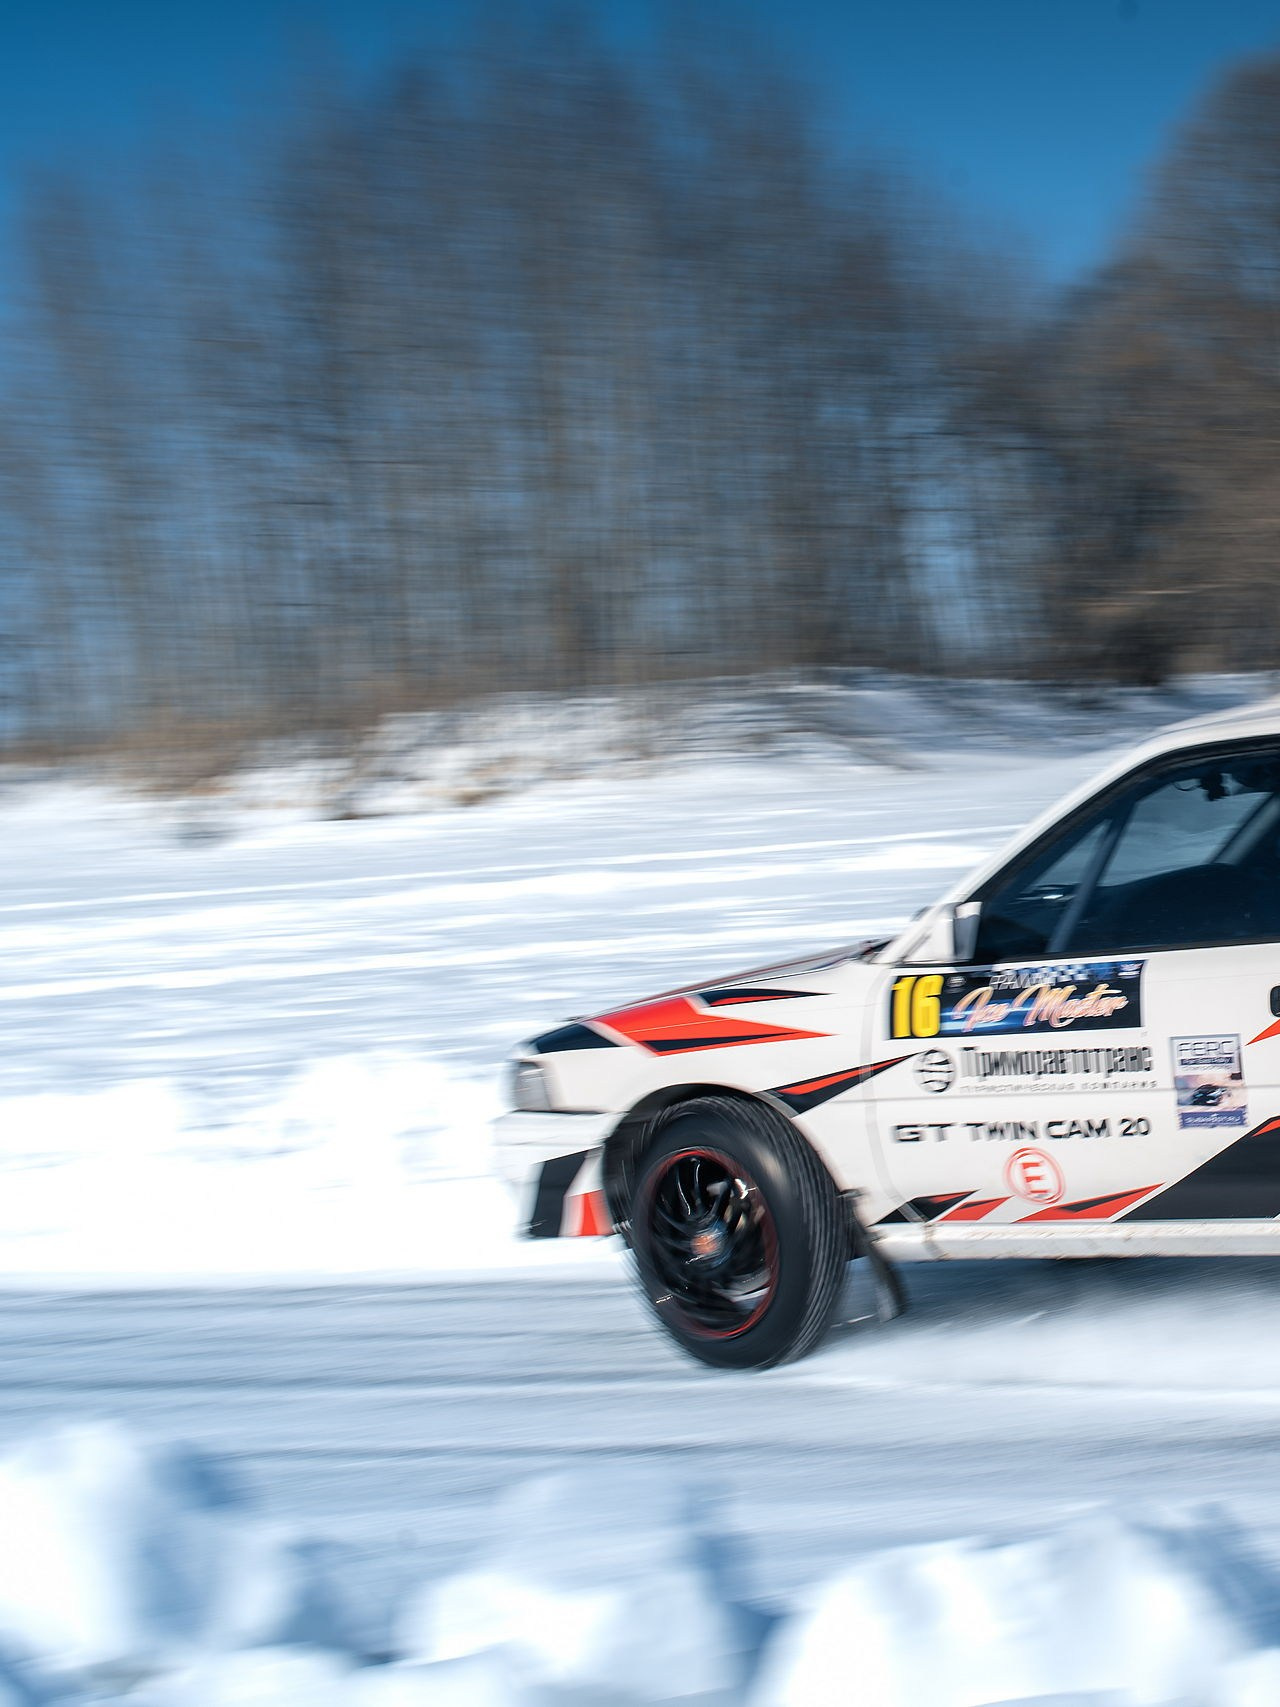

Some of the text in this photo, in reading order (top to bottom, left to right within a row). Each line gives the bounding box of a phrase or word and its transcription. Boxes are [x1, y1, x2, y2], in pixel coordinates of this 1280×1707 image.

[892, 974, 945, 1039] 16
[892, 1117, 1152, 1143] GT TWIN CAM 20
[1021, 1160, 1051, 1195] E
